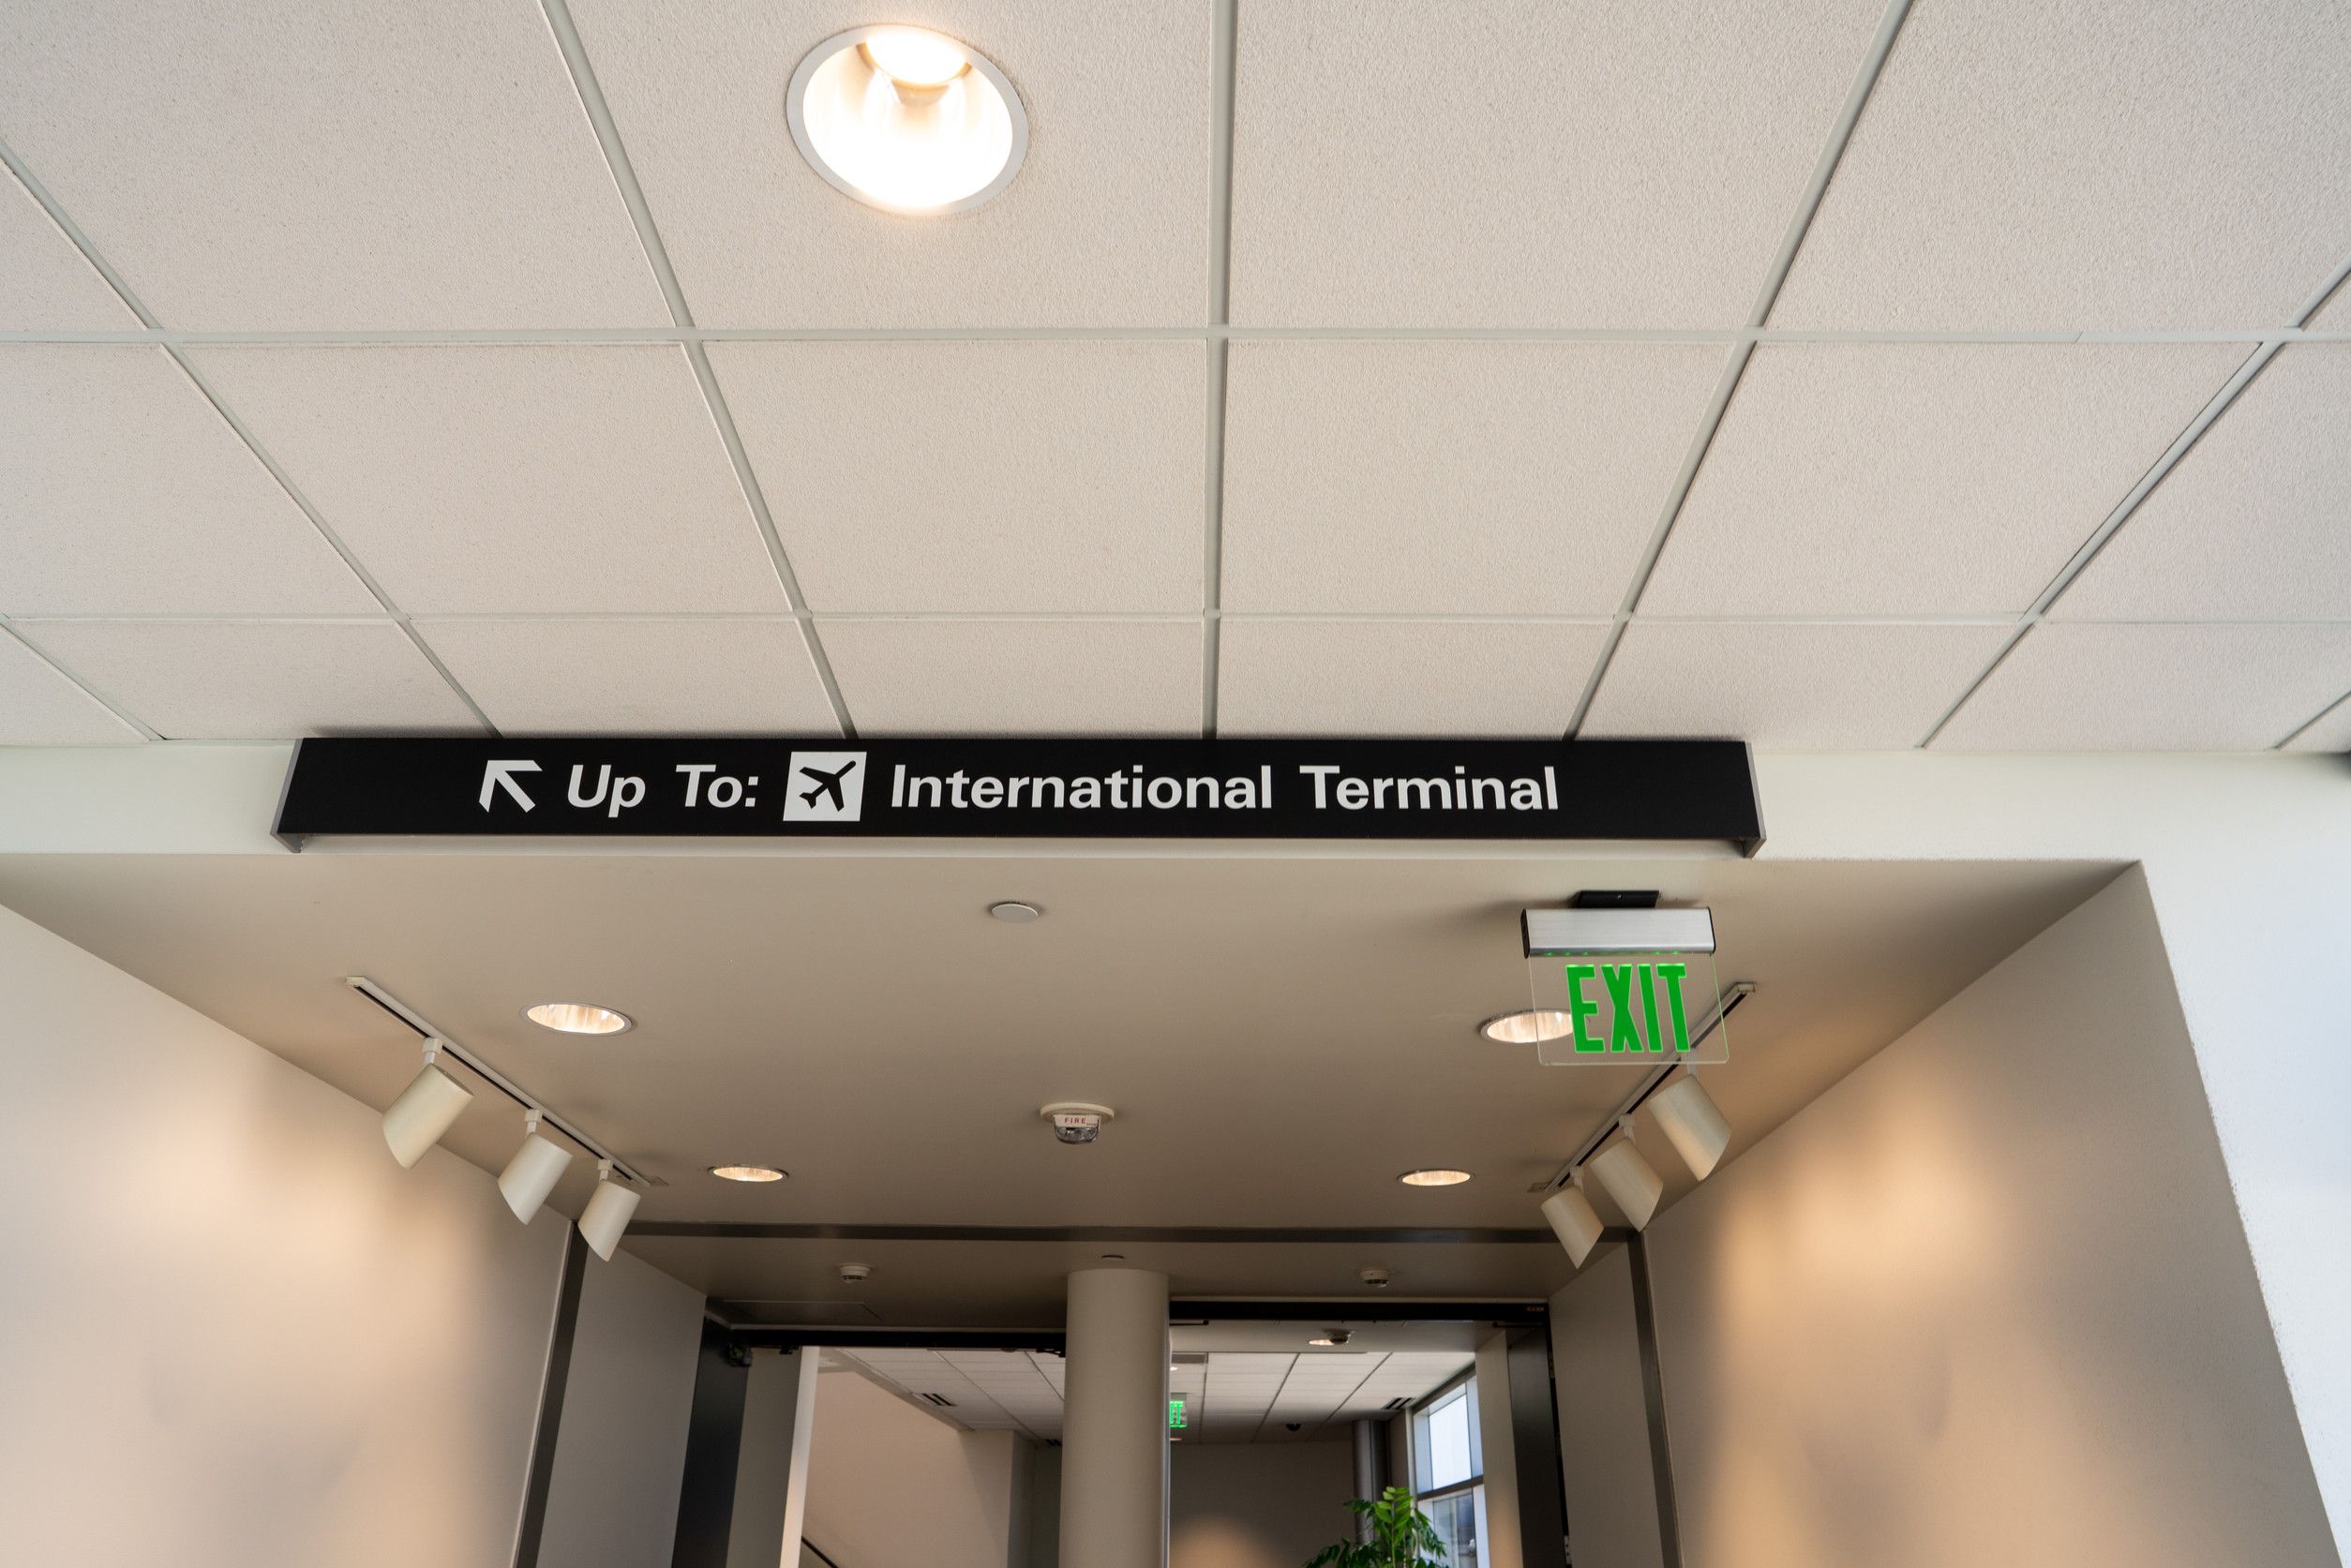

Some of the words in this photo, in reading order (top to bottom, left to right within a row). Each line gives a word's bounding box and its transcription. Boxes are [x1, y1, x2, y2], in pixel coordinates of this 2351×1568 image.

[567, 764, 646, 818] Up
[675, 764, 759, 808] To:
[891, 764, 1272, 810] International
[1299, 765, 1559, 811] Terminal
[1565, 963, 1690, 1053] EXIT
[1064, 1116, 1086, 1125] FIRE
[1170, 1401, 1184, 1425] IT
